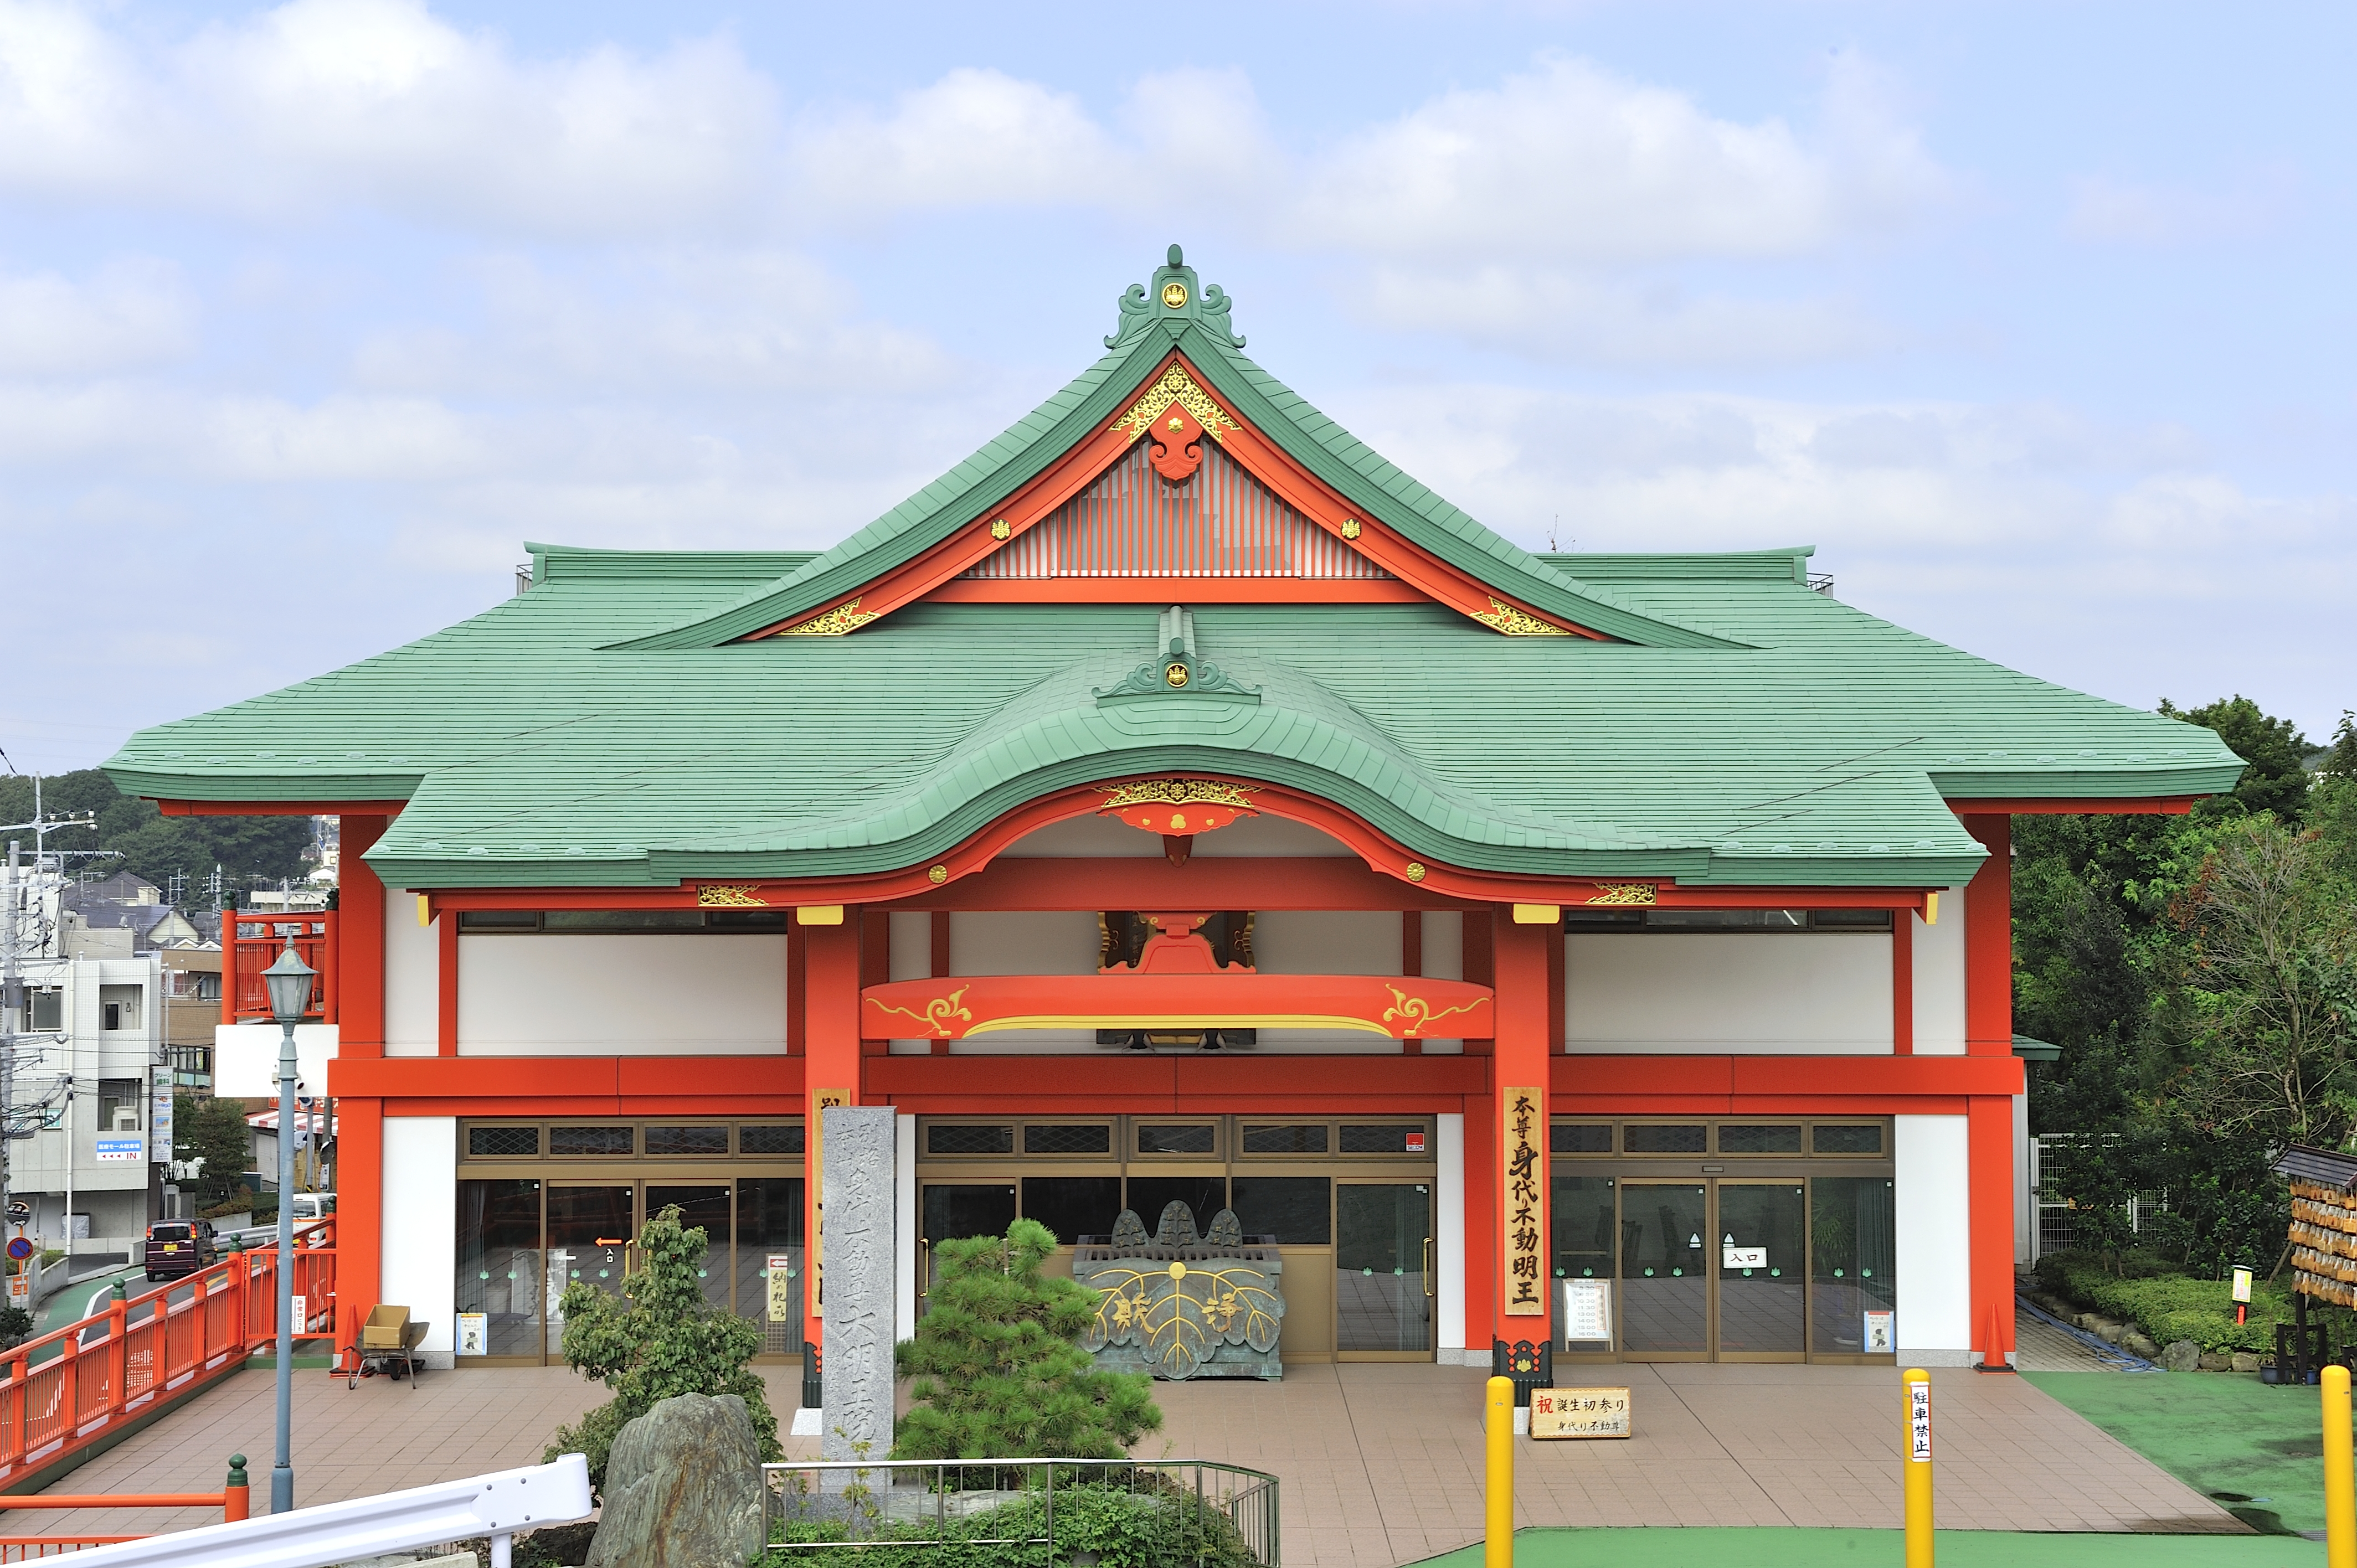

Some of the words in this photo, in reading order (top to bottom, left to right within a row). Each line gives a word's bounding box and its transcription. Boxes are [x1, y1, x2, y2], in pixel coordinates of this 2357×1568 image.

[606, 1248, 614, 1263] 入口
[1729, 1254, 1758, 1262] 入口
[1557, 1421, 1619, 1432] 身代り不動尊
[1912, 1391, 1930, 1453] 駐車禁止
